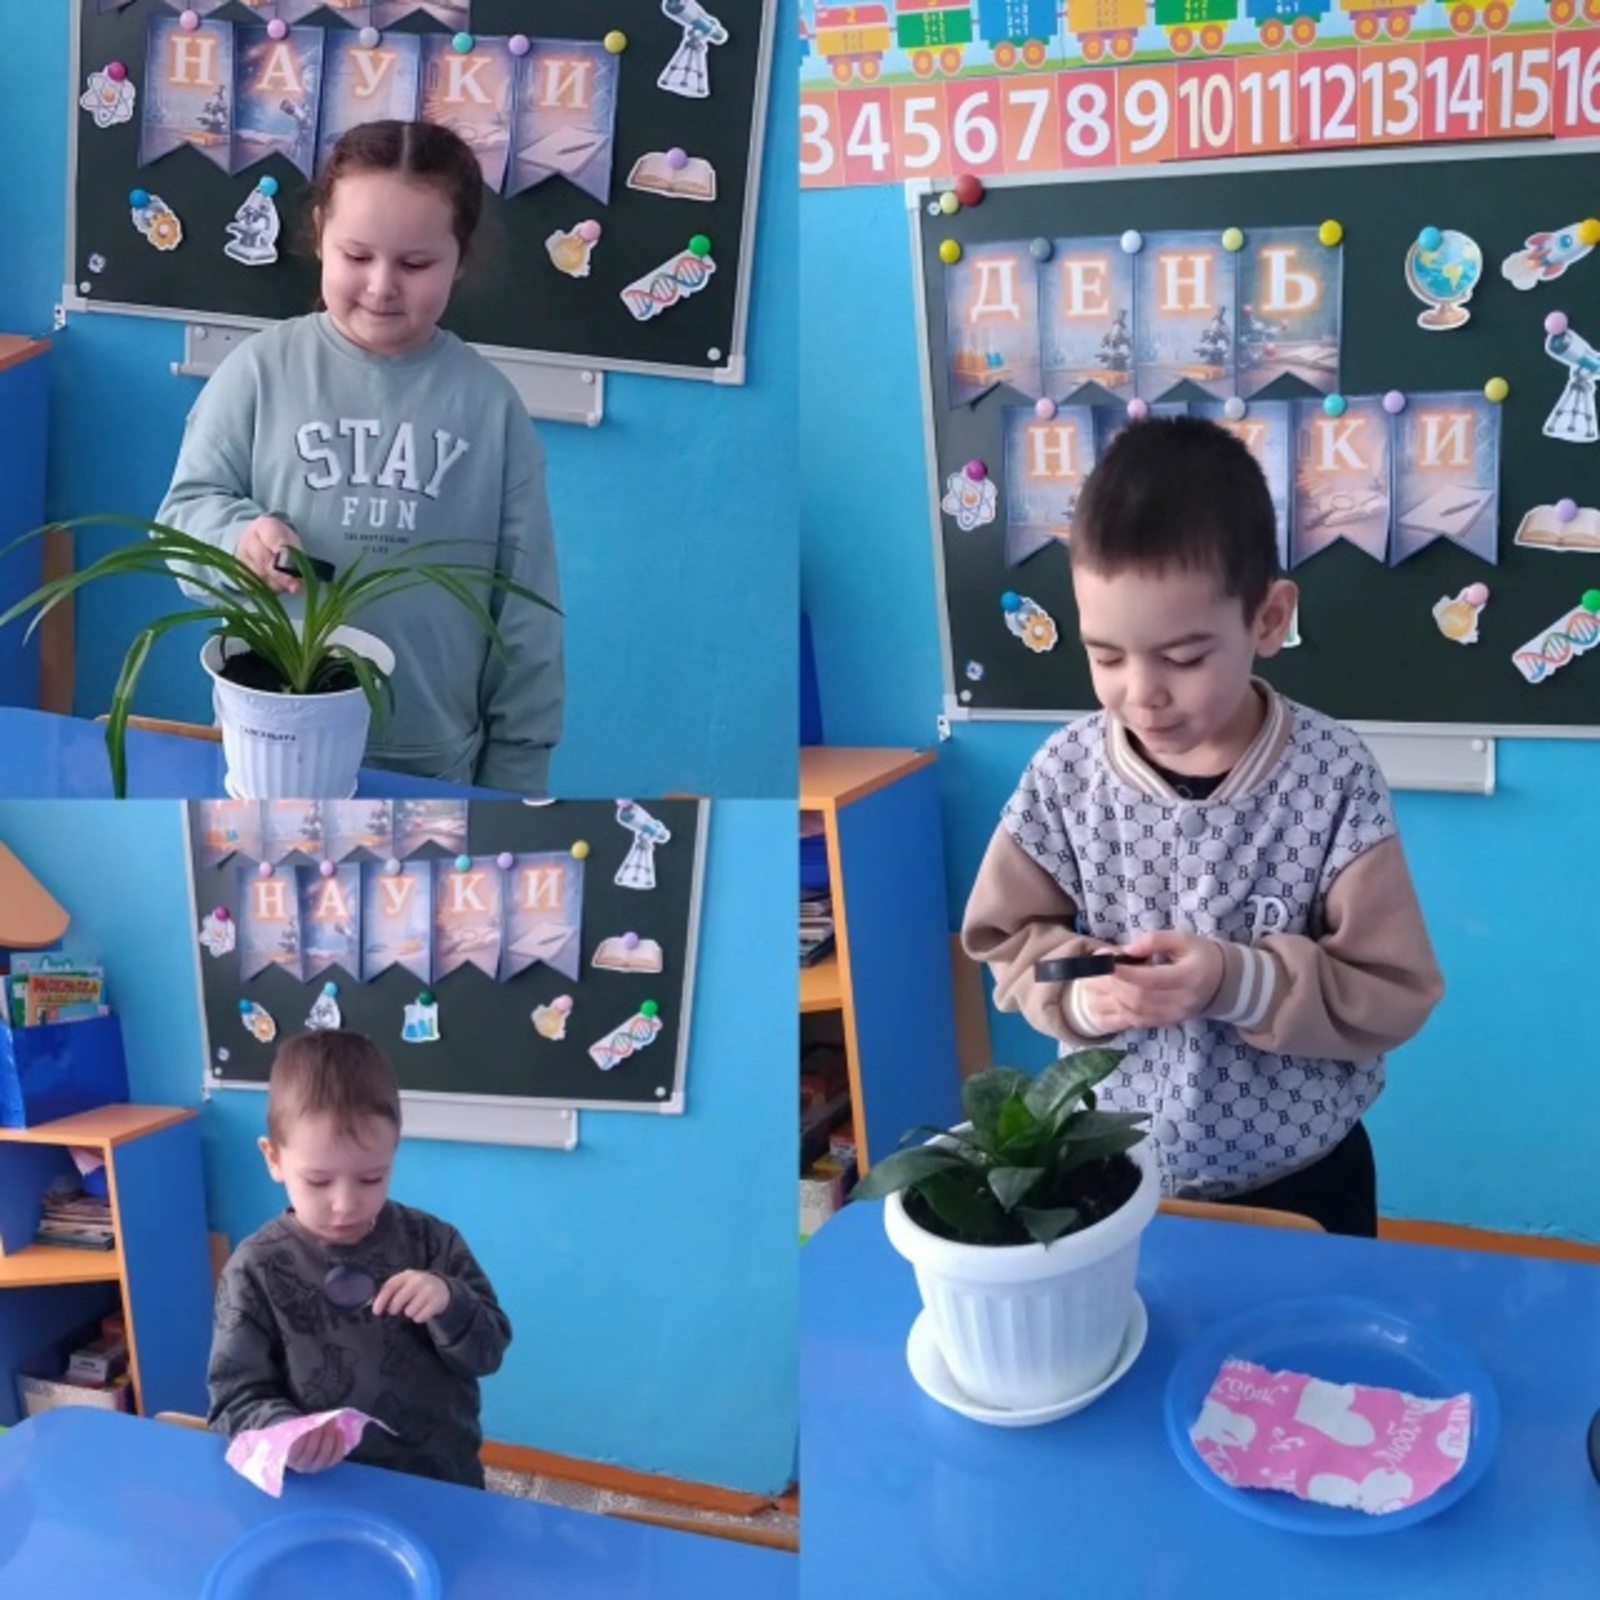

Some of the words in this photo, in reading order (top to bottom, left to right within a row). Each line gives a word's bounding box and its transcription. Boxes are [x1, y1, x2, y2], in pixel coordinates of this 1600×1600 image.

[170, 36, 592, 109] НАУКИ
[847, 102, 890, 171] 4
[904, 97, 941, 168] 5
[954, 92, 997, 164] 6
[1009, 89, 1049, 161] 7
[1066, 83, 1111, 156] 8
[1124, 79, 1168, 153] 9
[1179, 73, 1233, 149] 10
[1240, 69, 1292, 145] 11
[1299, 64, 1356, 141] 12
[1362, 57, 1419, 137] 13
[1425, 54, 1483, 133] 14
[1491, 48, 1550, 129] 15
[971, 249, 1319, 321] ДЕНЬ
[295, 417, 470, 500] STAY
[341, 497, 418, 530] FUN
[254, 867, 564, 919] НАУКИ
